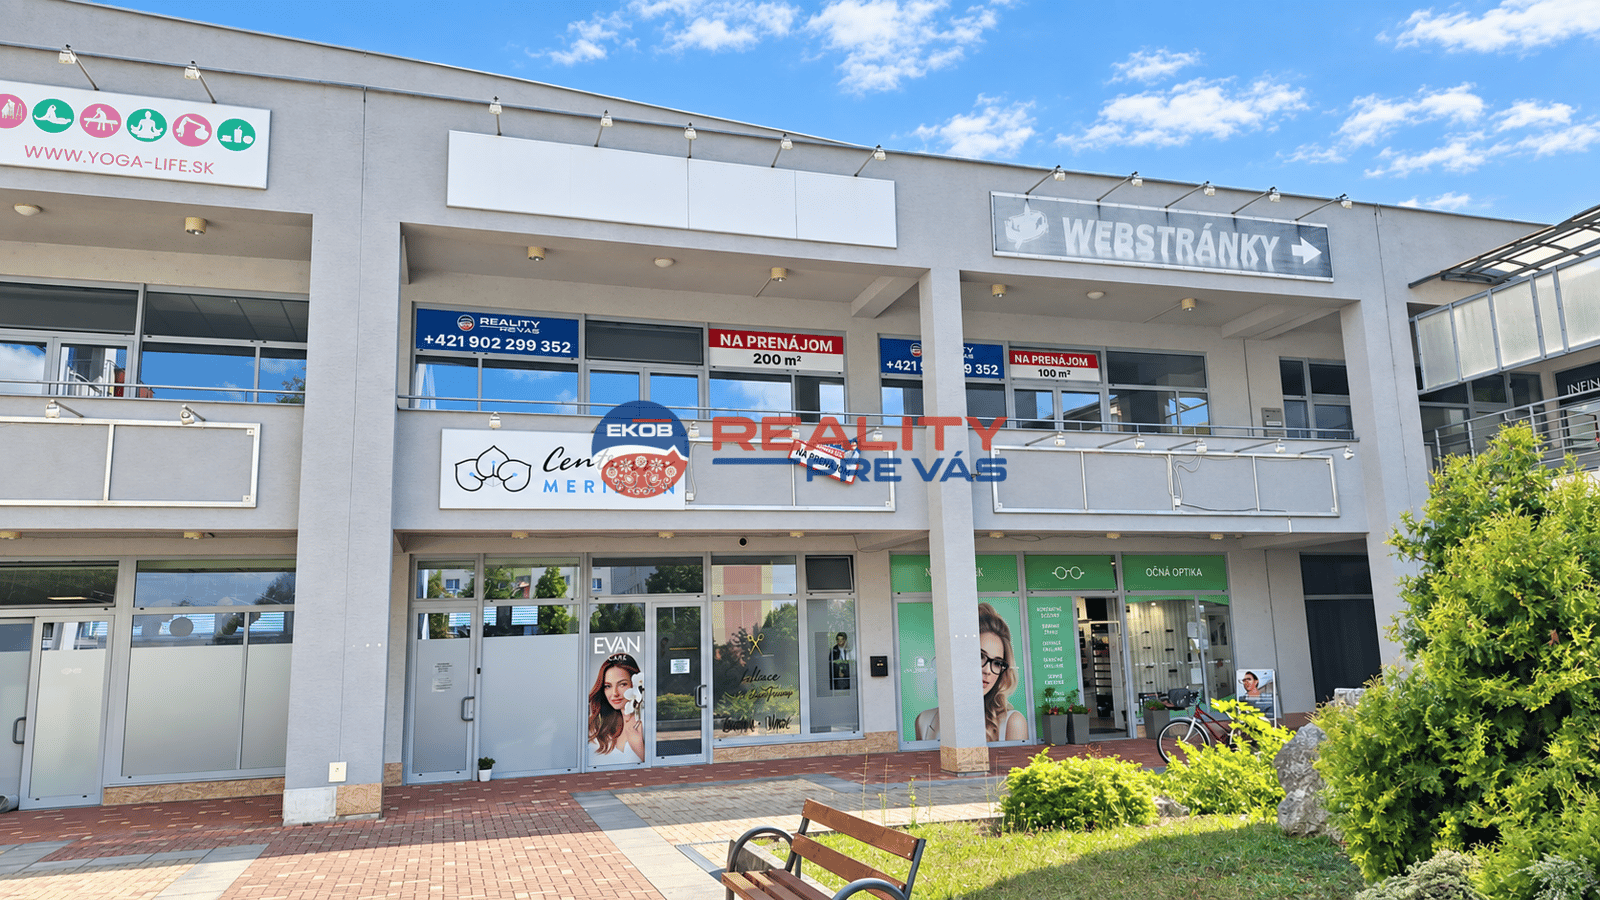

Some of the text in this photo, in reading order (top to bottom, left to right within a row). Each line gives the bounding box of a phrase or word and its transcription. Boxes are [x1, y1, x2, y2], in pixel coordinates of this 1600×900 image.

[24, 144, 215, 175] WWW.YOGA-LIFE.SK
[1062, 216, 1280, 264] WEBSTRÁNKY
[479, 317, 541, 329] REALITY
[424, 334, 571, 353] +421 902 299 352
[720, 333, 833, 352] NA PRENÁJOM
[753, 353, 801, 366] 200 m²
[1014, 354, 1089, 367] NA PRENÁJOM
[886, 360, 917, 371] +421
[975, 364, 999, 376] 352
[1038, 368, 1071, 378] 100 m²
[795, 448, 808, 458] NA
[1145, 565, 1203, 577] OČNÁ OPTIKA
[594, 635, 640, 654] EVAN
